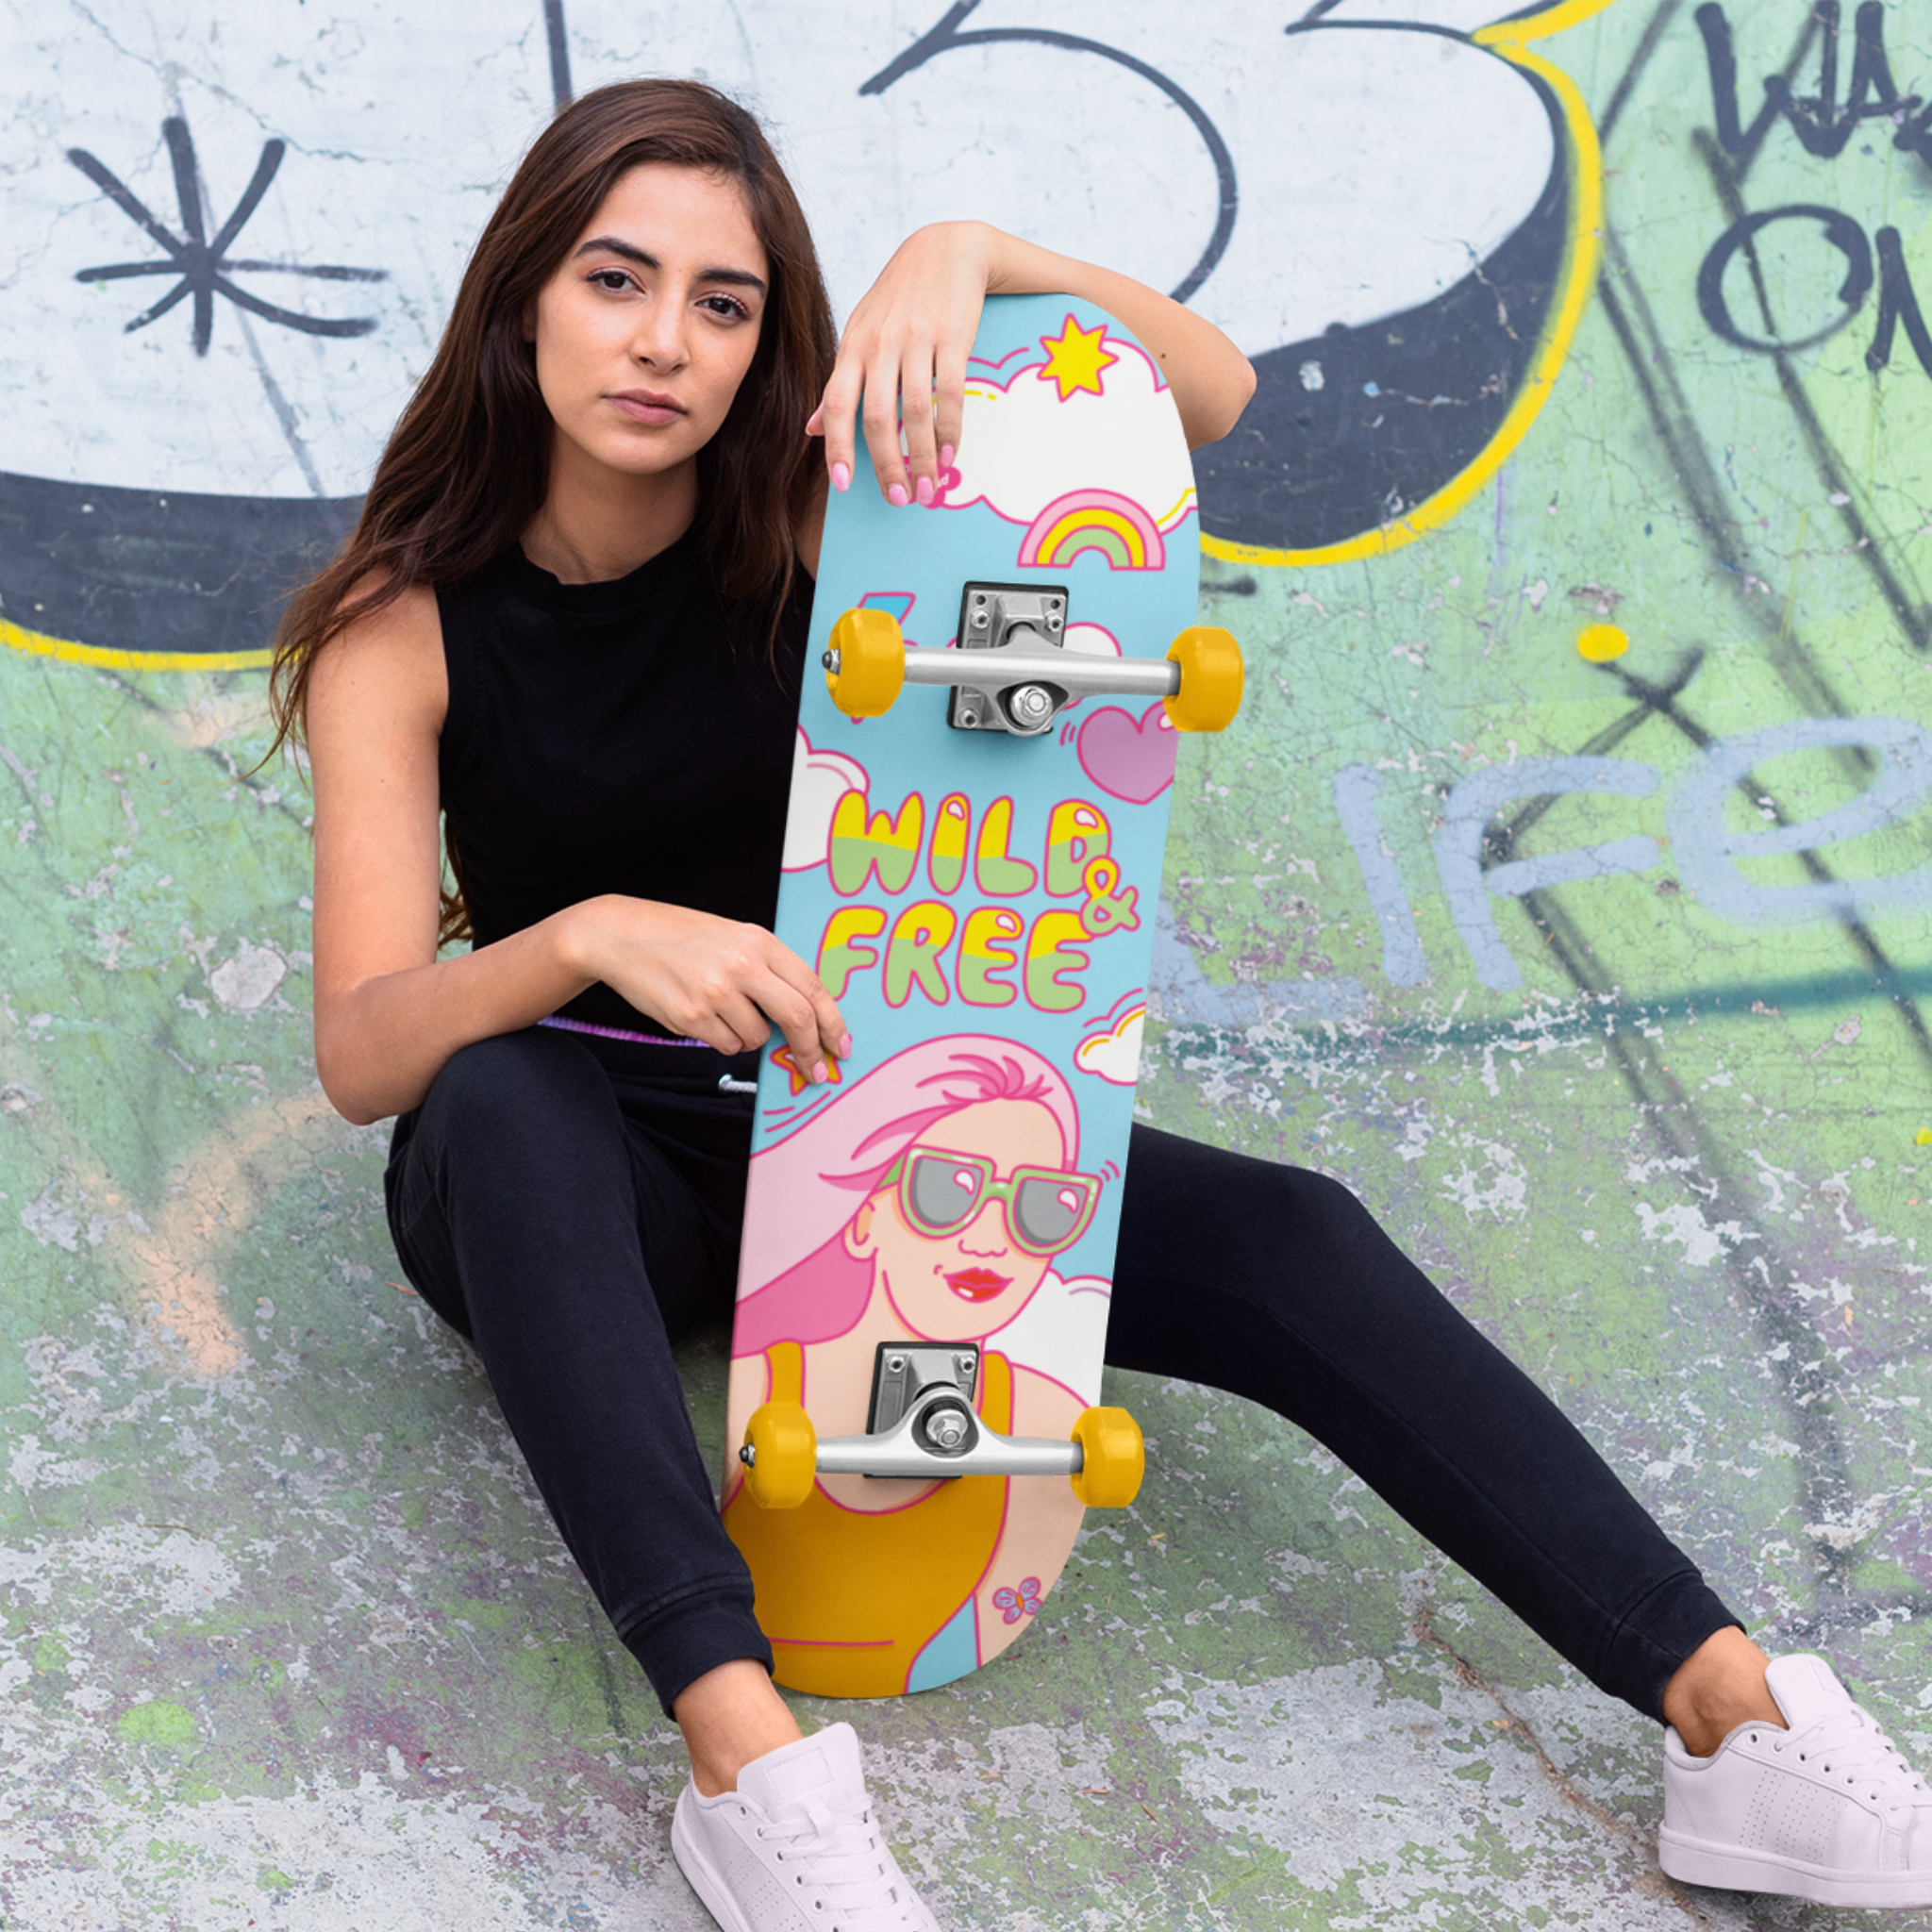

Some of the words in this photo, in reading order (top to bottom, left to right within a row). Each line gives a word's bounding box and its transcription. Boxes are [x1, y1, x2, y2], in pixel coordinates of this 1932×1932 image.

[826, 788, 1112, 898] WILD
[1079, 855, 1141, 937] &
[815, 899, 1095, 1014] FREE
